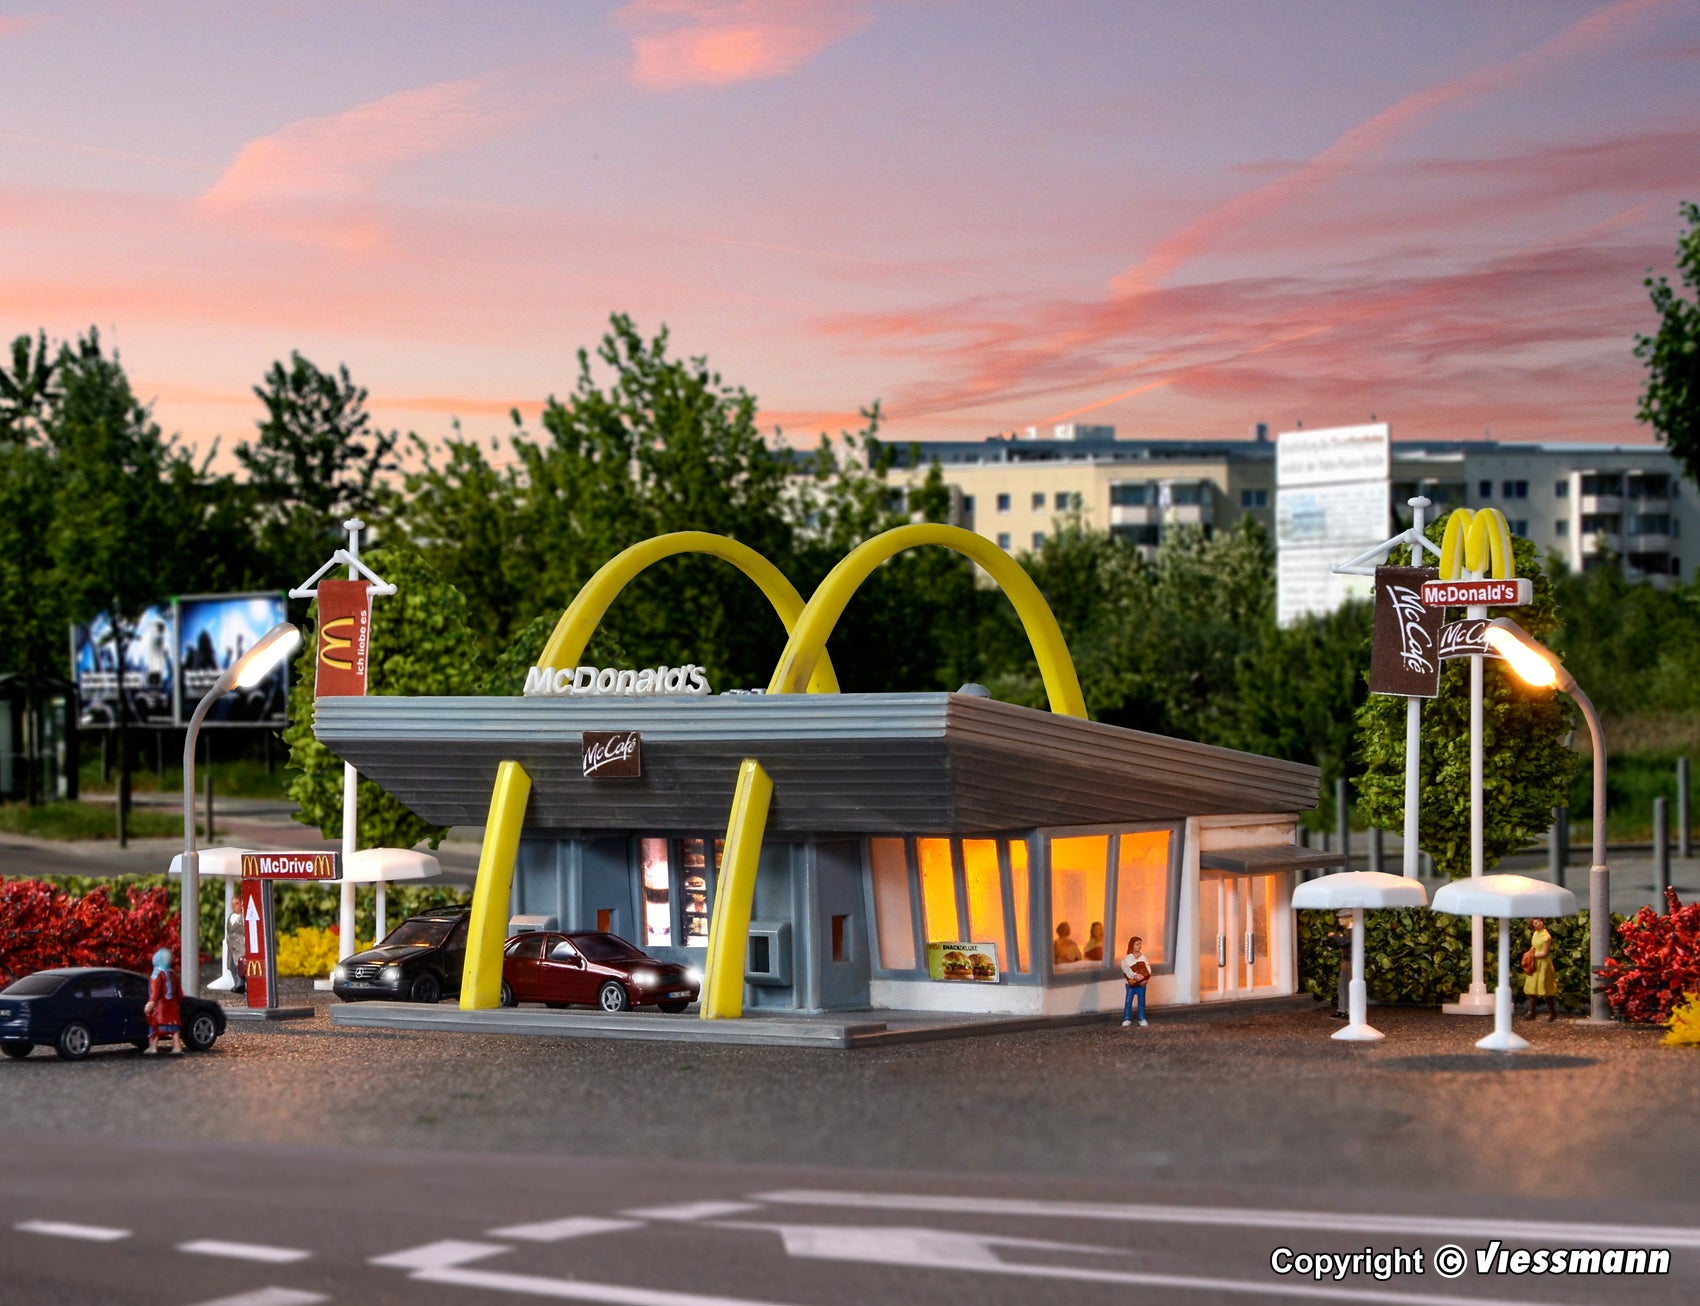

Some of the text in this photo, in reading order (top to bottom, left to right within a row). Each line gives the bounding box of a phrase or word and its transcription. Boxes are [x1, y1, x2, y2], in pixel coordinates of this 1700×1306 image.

[1424, 585, 1515, 604] McDonald's
[356, 658, 364, 676] ich
[360, 609, 367, 625] es
[1391, 585, 1434, 675] McCafé
[523, 663, 713, 696] McDonald's
[583, 731, 638, 772] McCafé
[260, 857, 314, 875] McDrive
